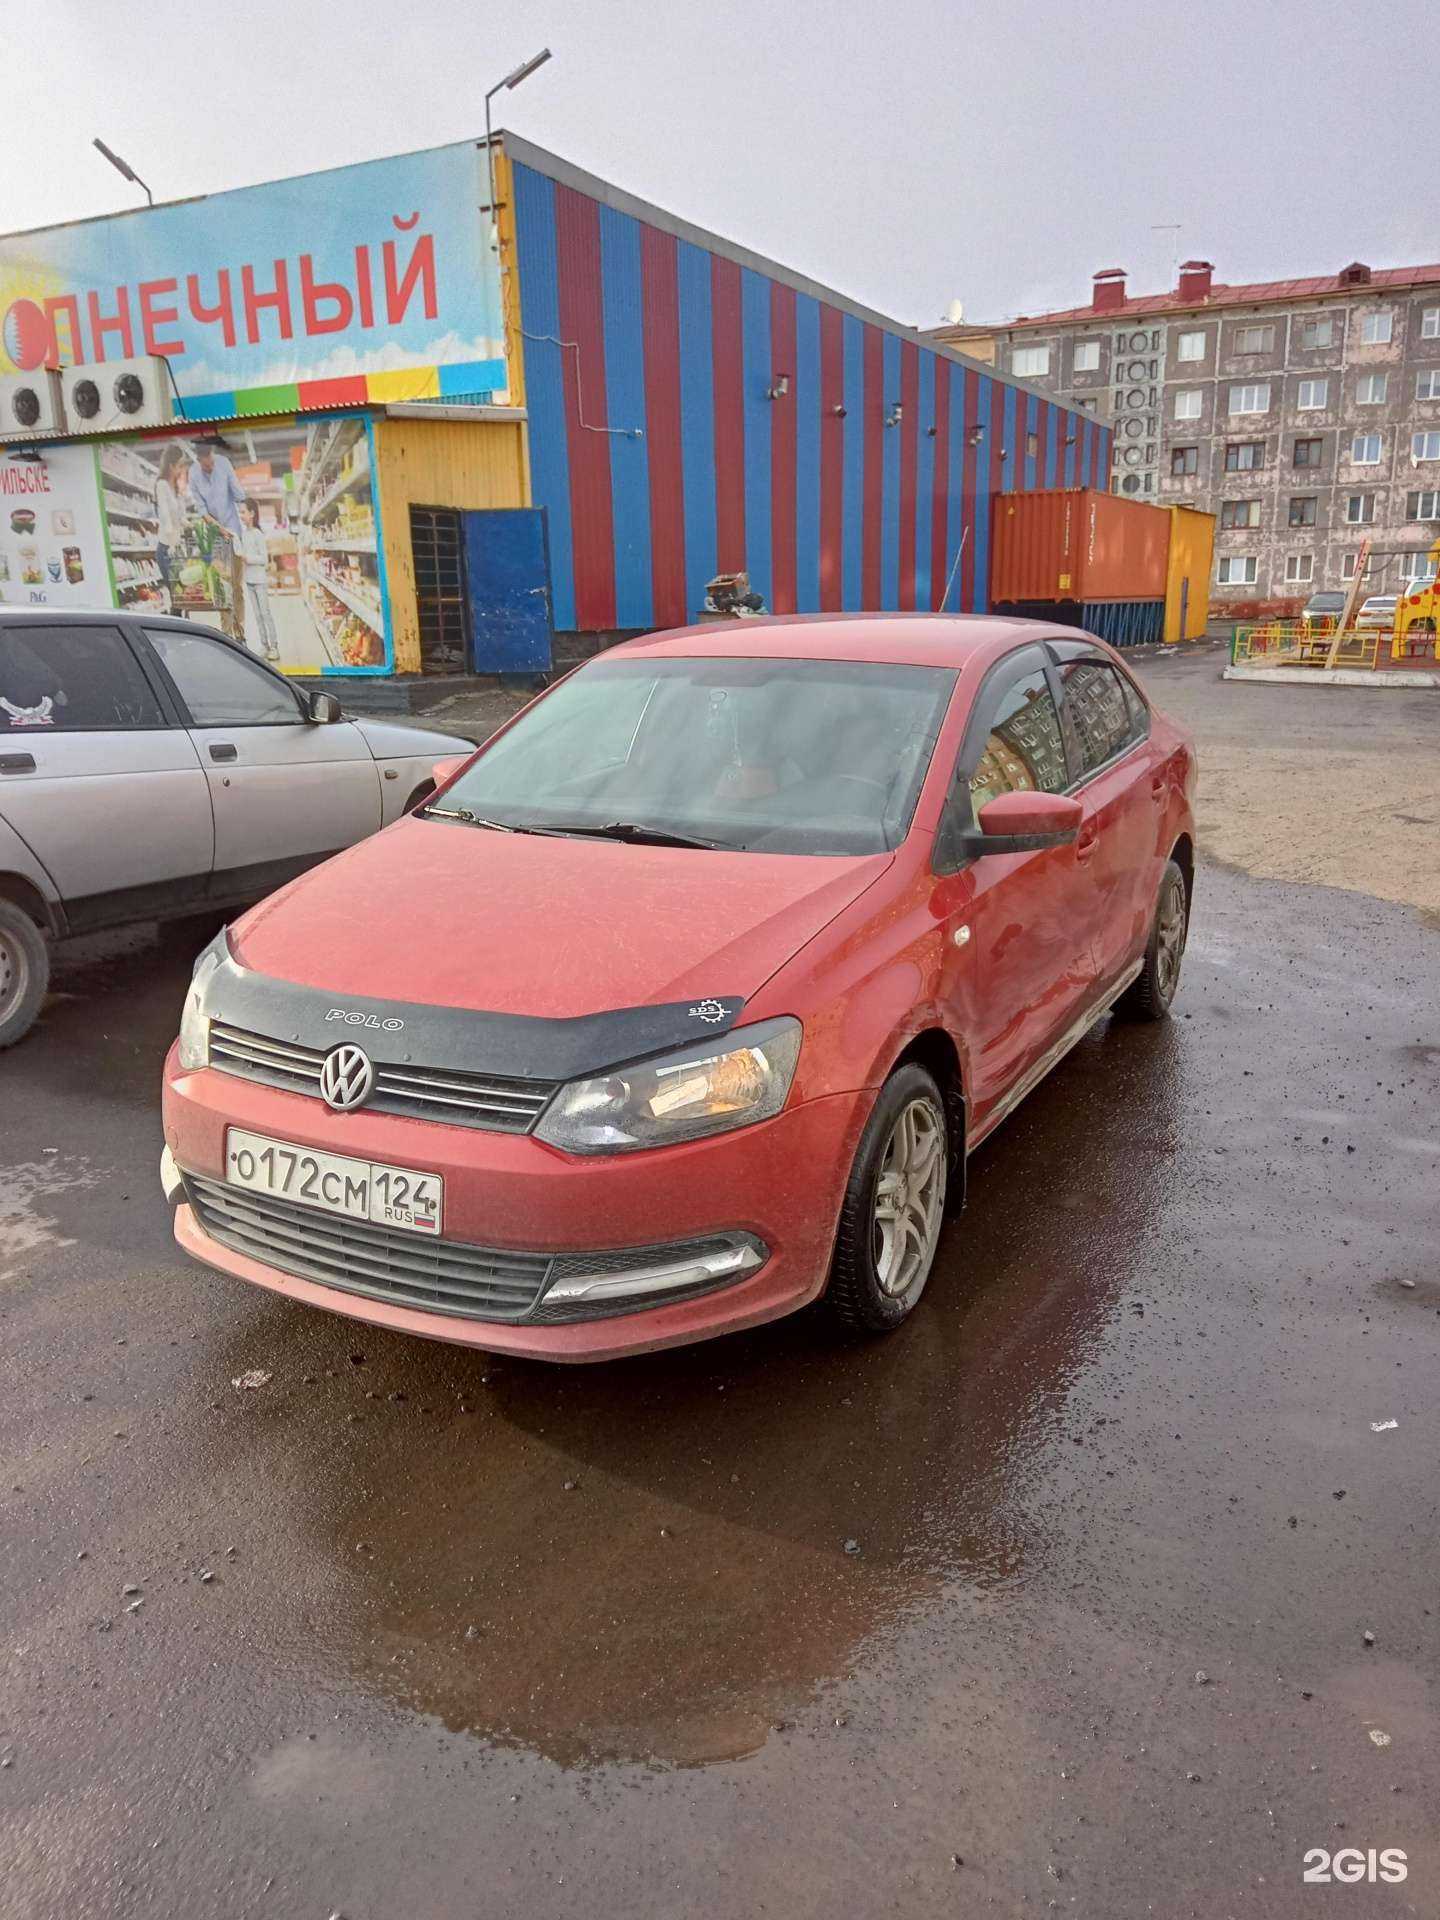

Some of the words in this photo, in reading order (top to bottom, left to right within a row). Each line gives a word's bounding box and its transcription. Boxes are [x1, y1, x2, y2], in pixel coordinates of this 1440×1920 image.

[0, 465, 50, 494] ИЛЬСКЕ
[688, 1005, 716, 1014] SDS
[324, 1008, 404, 1031] POLO
[384, 1207, 413, 1223] RUS
